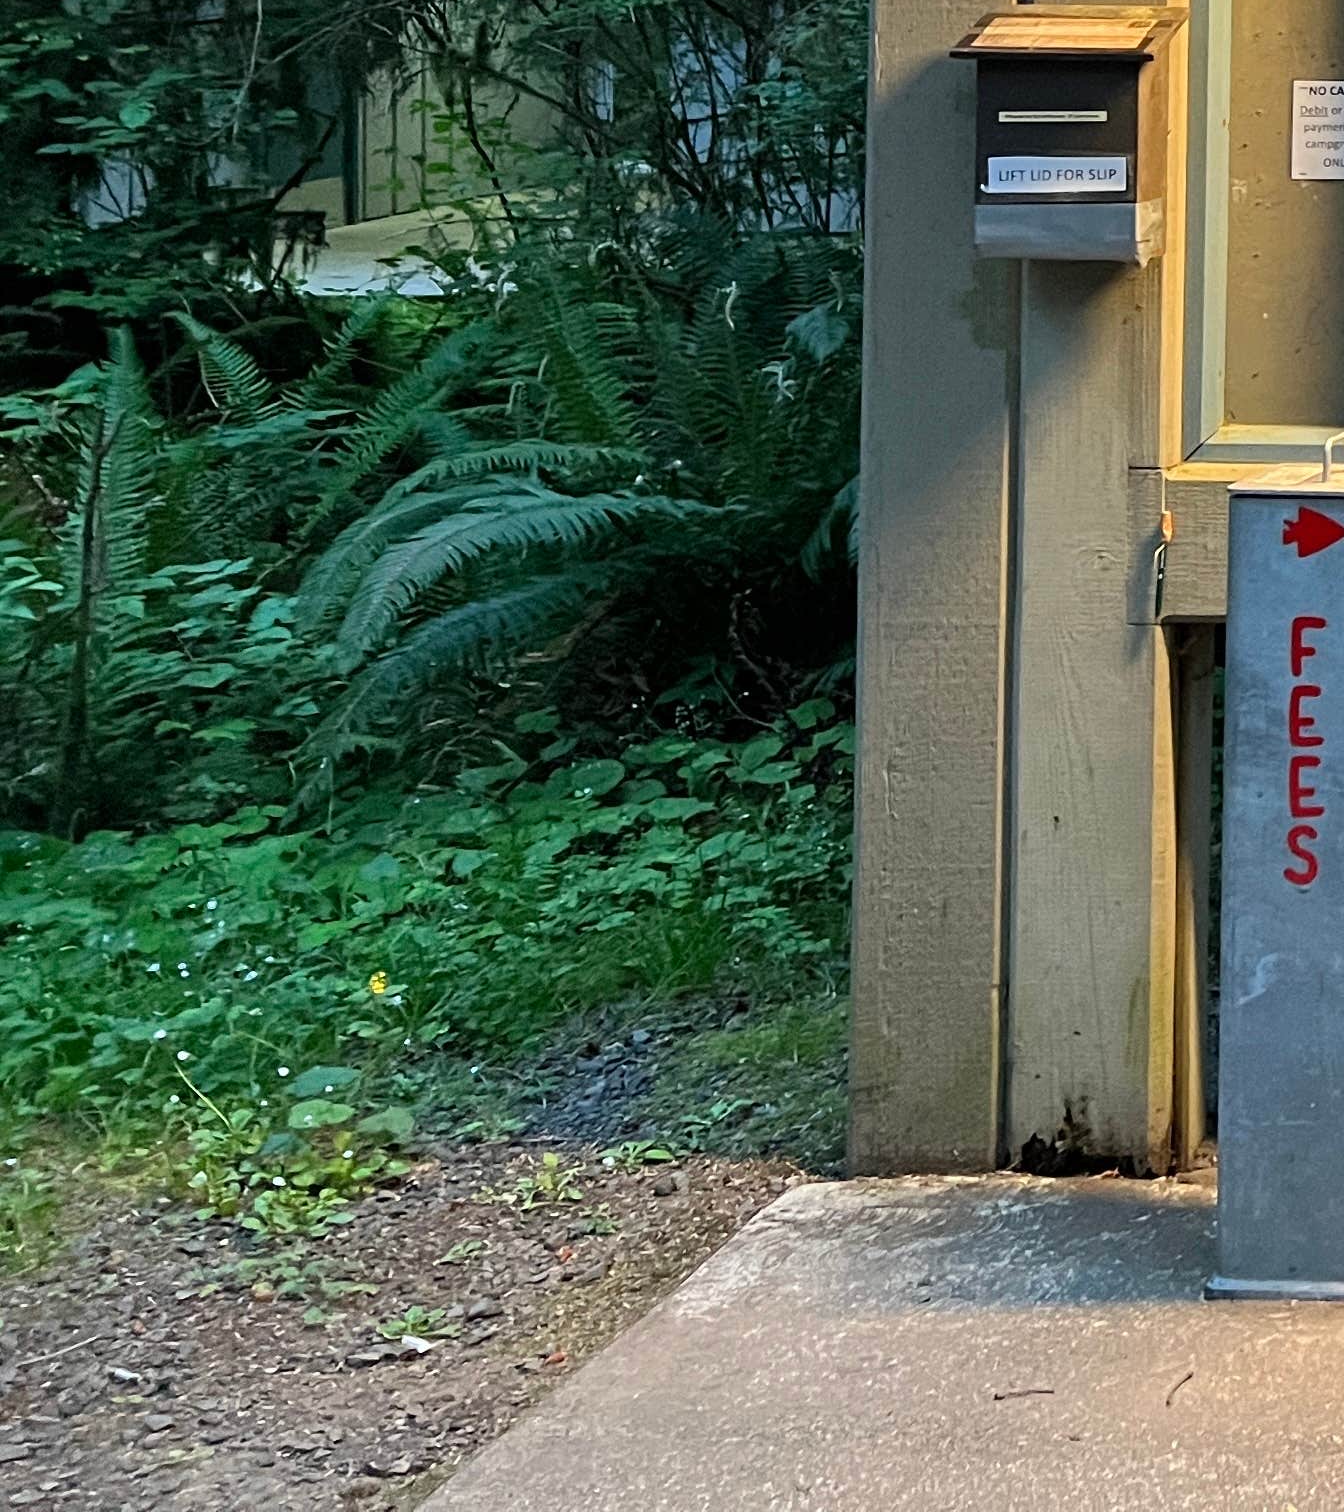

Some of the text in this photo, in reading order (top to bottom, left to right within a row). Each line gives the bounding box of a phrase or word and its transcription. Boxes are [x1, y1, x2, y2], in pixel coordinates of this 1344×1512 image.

[1309, 86, 1327, 96] NO
[1300, 105, 1329, 116] Debit
[1331, 107, 1342, 115] or
[999, 168, 1117, 182] LIFT LID FOR SLIP
[1283, 616, 1327, 886] FEES
